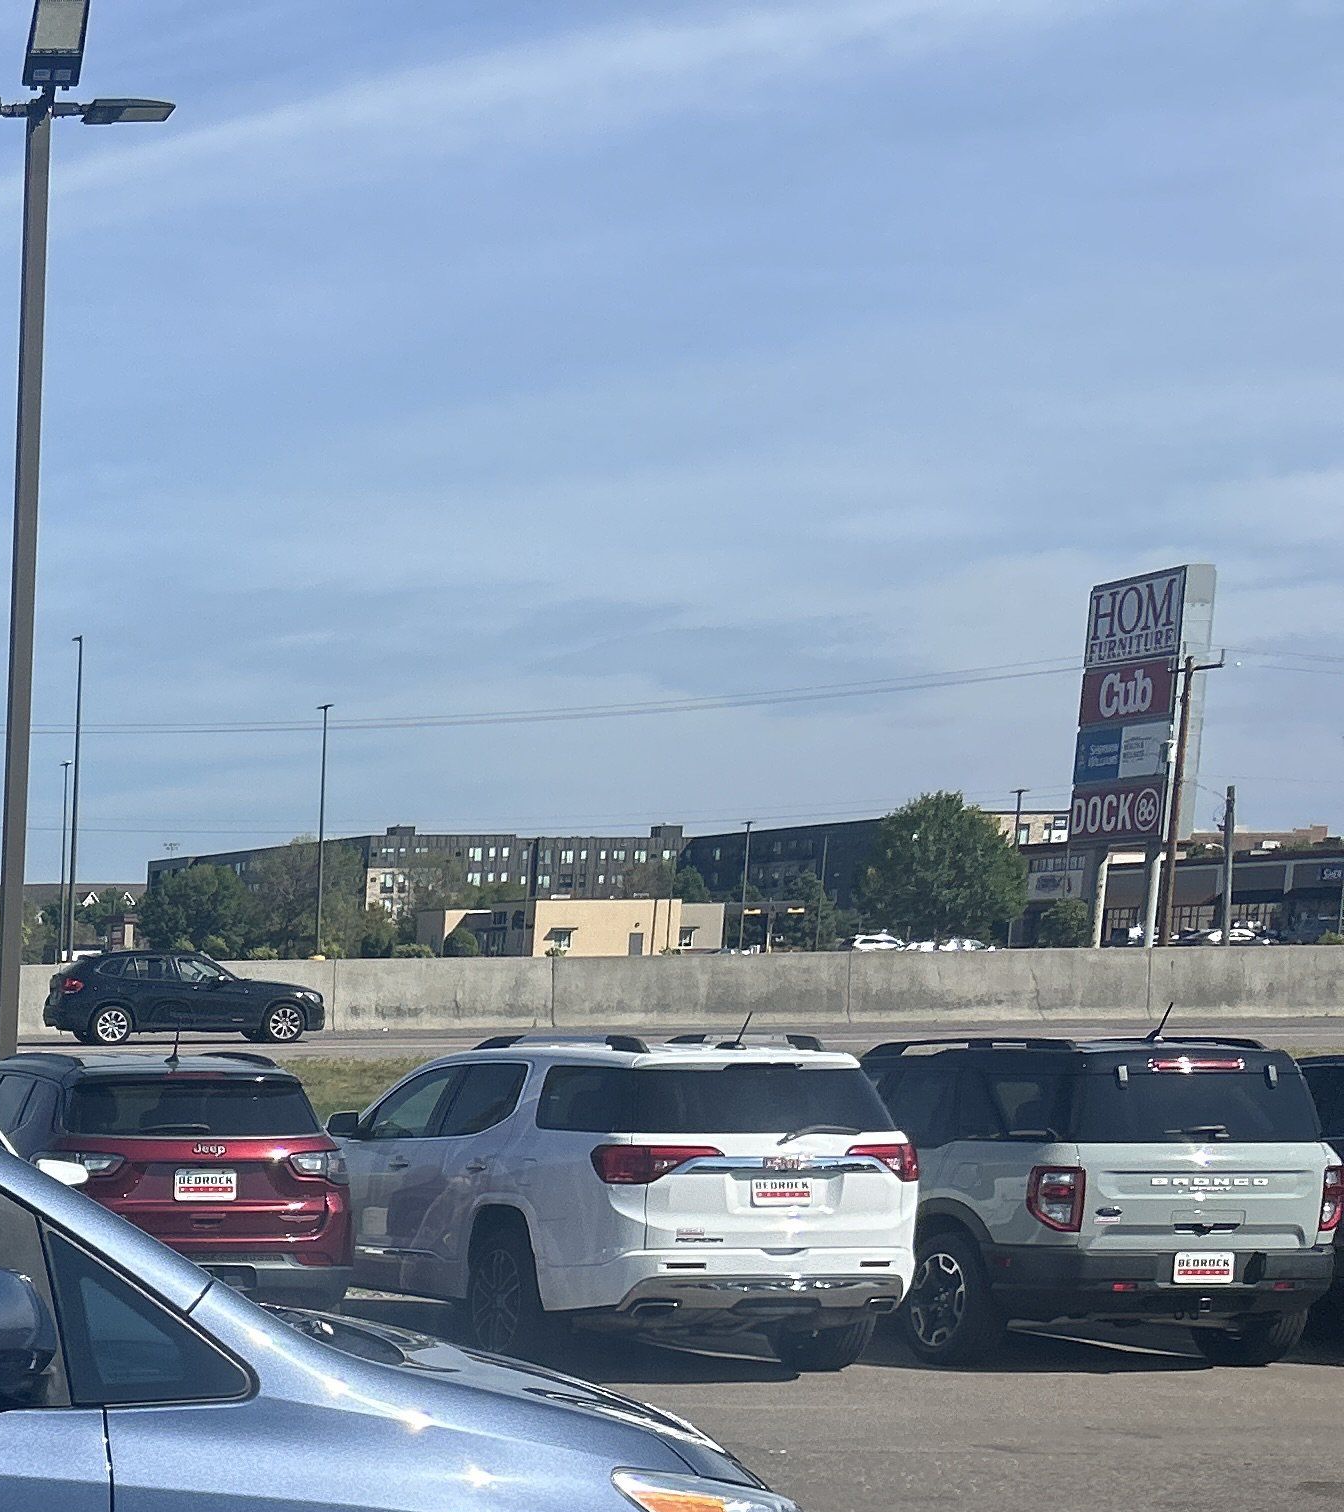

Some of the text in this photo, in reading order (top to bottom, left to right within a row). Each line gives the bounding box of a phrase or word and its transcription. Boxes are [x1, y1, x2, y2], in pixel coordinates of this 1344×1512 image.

[1091, 578, 1176, 641] HOM
[1087, 628, 1175, 663] FURNITURE
[1099, 668, 1153, 718] Cub
[1072, 792, 1134, 835] DOCK
[193, 1143, 227, 1157] Jeep
[178, 1176, 233, 1185] BEDROCK
[755, 1181, 810, 1190] BEDROCK
[1177, 1258, 1230, 1268] BEDROCK
